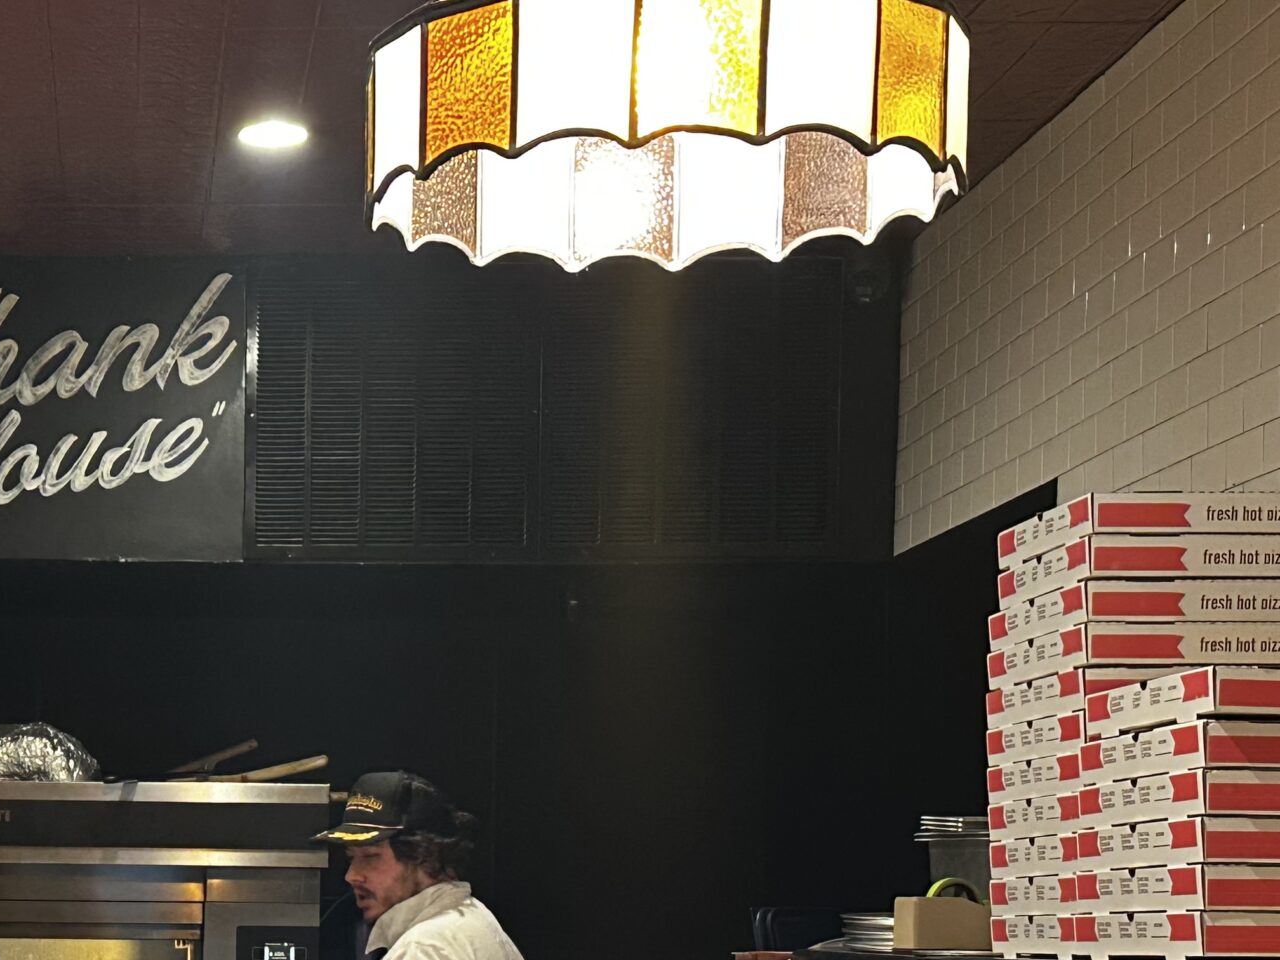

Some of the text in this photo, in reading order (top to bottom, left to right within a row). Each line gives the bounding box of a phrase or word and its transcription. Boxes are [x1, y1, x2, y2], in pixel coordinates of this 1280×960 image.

[1207, 506, 1238, 522] fresh
[1243, 506, 1262, 522] hot
[1204, 549, 1235, 565] fresh
[1240, 550, 1259, 565] hot
[1201, 594, 1280, 610] fresh hot piz
[1200, 636, 1256, 653] fresh hot
